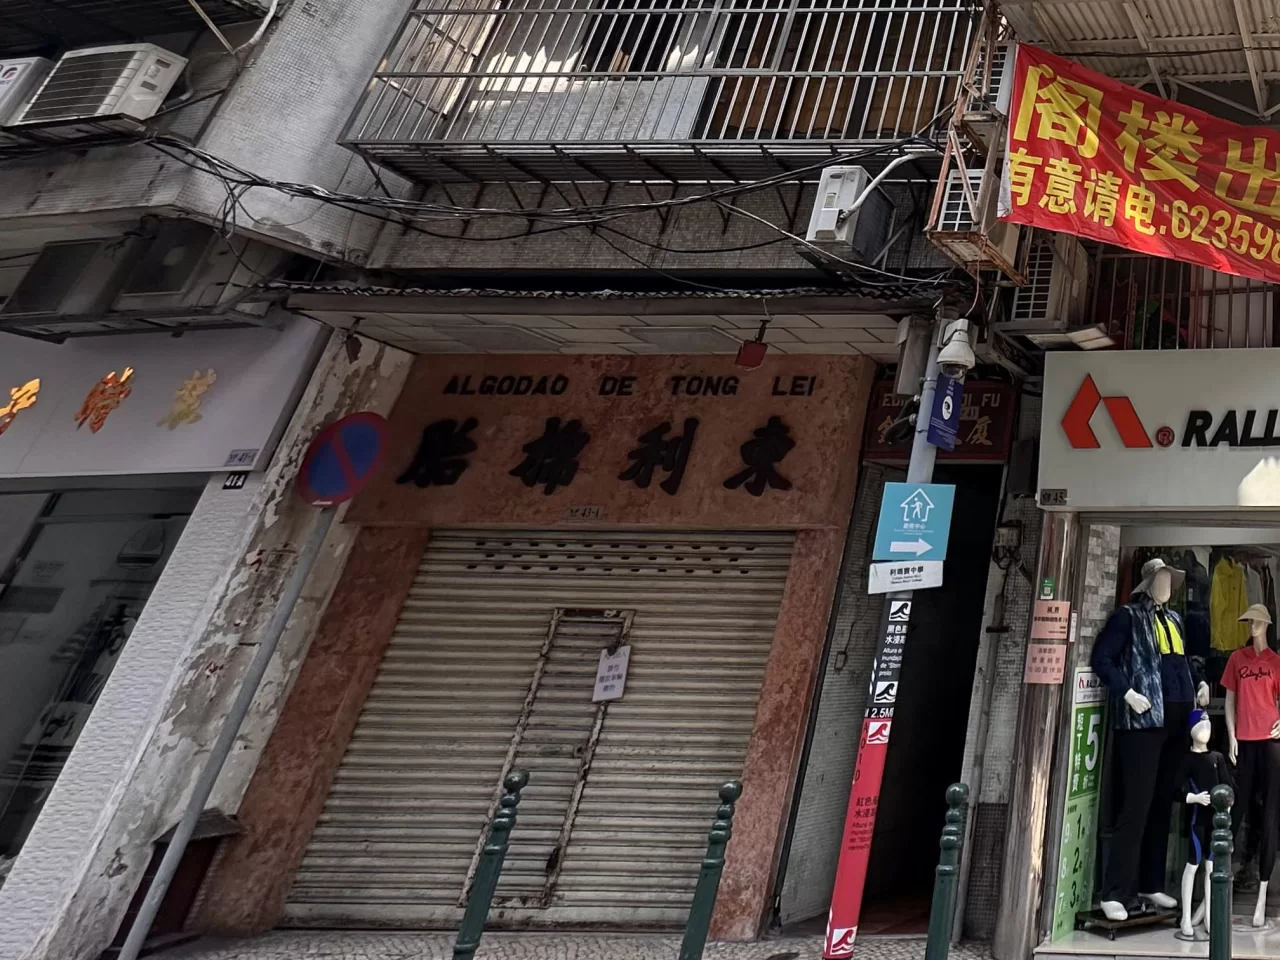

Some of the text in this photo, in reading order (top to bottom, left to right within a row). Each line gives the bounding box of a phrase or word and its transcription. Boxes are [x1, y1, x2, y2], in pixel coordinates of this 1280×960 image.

[442, 375, 816, 396] ALGODAO DE TONG LEI
[1085, 714, 1101, 771] 5
